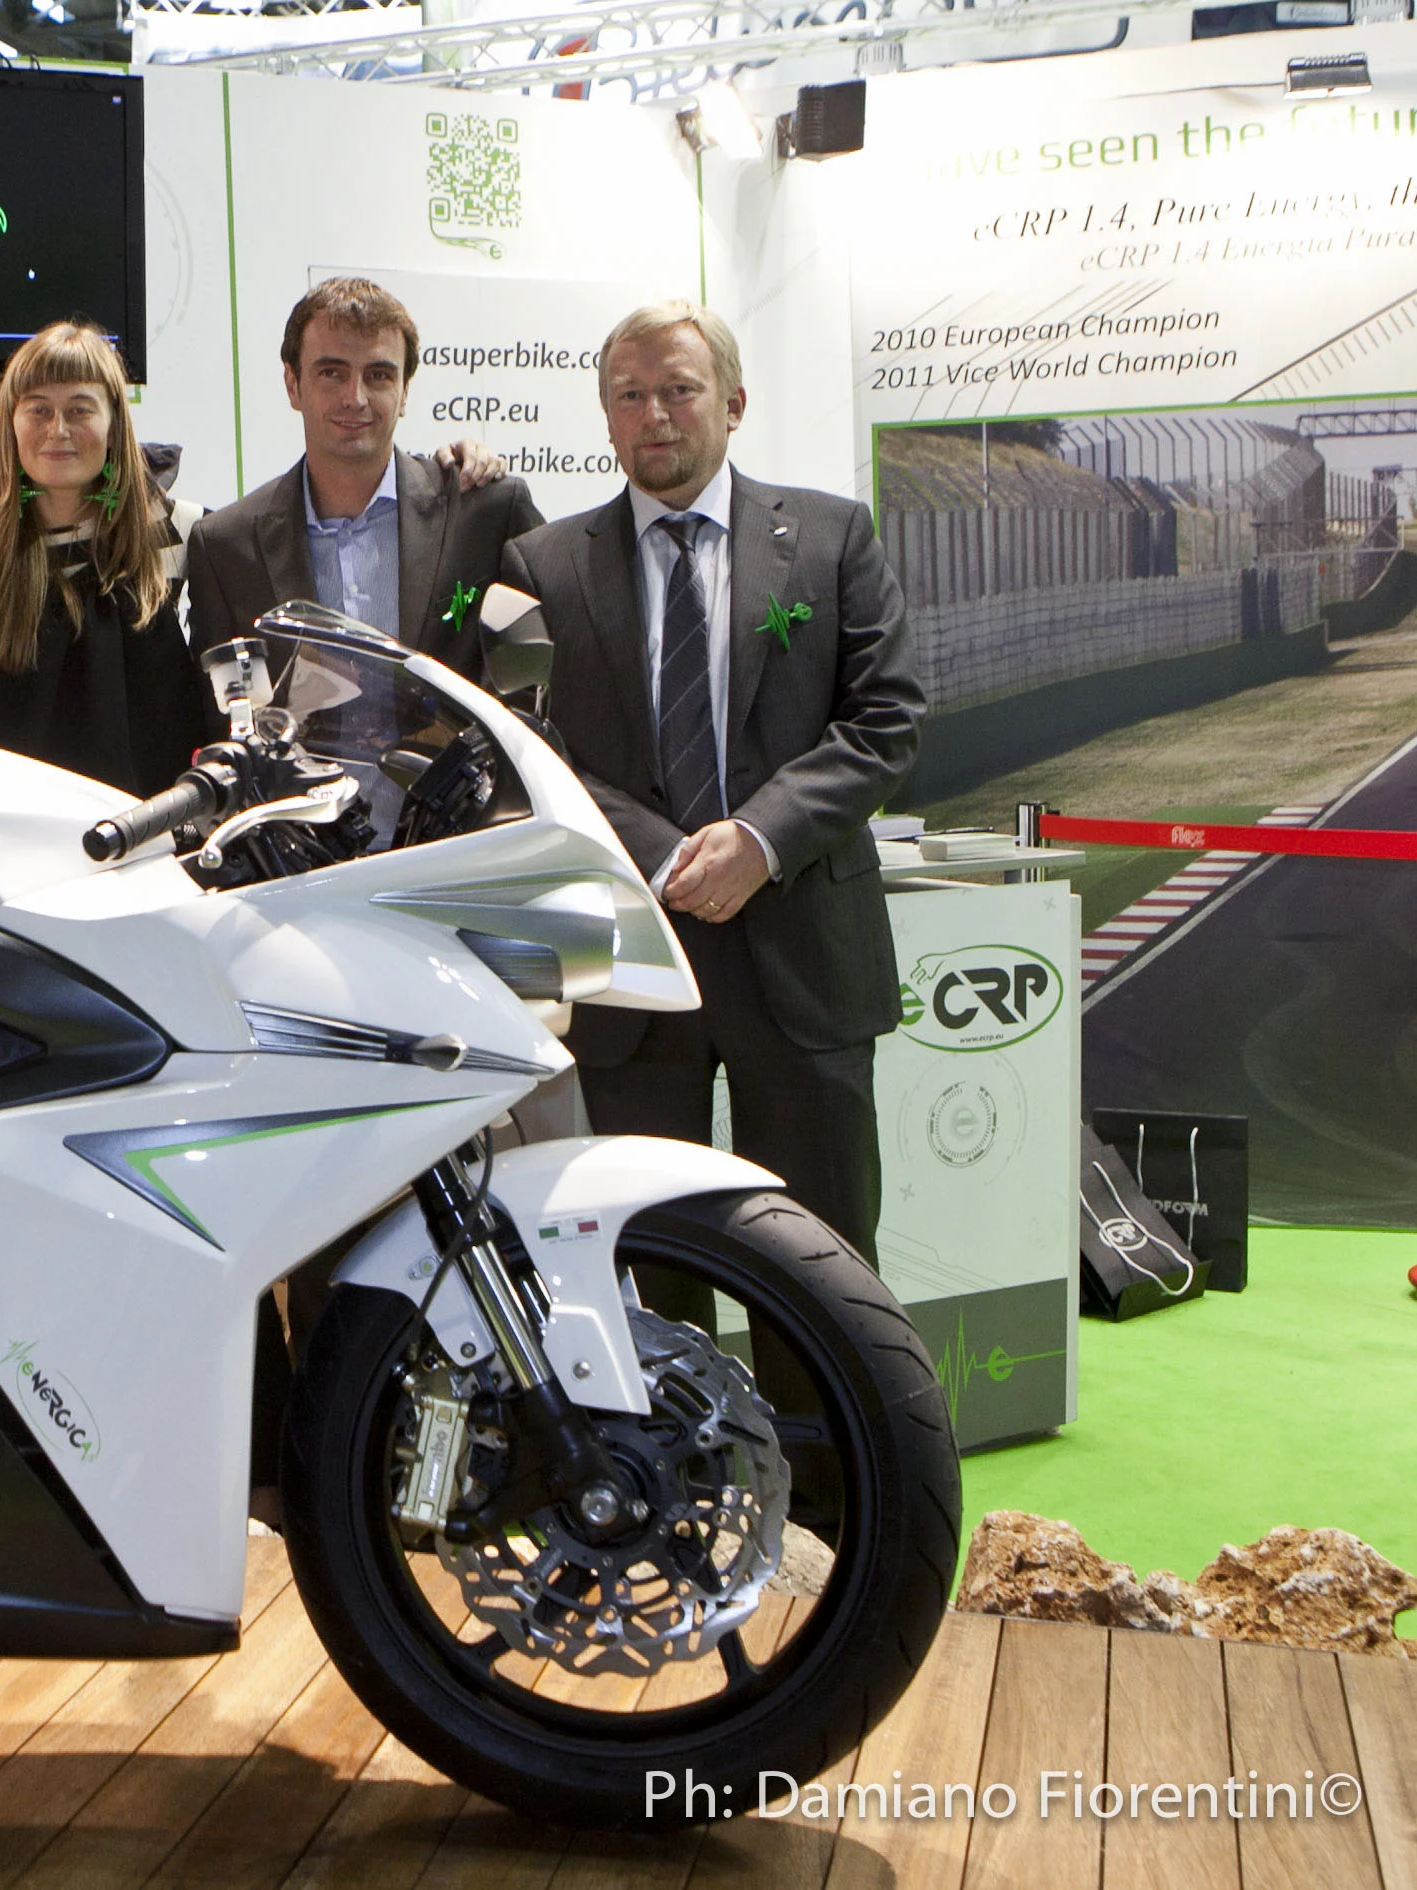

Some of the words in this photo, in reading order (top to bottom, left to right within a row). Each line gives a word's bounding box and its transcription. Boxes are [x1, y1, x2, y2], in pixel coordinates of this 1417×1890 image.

[1039, 132, 1160, 172] seen
[1177, 114, 1266, 159] the
[1081, 199, 1137, 237] 1.4,
[1151, 197, 1232, 227] Pure
[1079, 243, 1161, 273] eCRP
[1172, 239, 1211, 266] 1.4
[870, 327, 936, 354] 2010
[944, 319, 1071, 350] European
[1080, 308, 1221, 339] Champion
[871, 364, 935, 391] 2011
[946, 359, 999, 387] Vice
[1009, 353, 1089, 381] World
[1097, 346, 1238, 377] Champion
[432, 397, 539, 422] eCRP.eu
[959, 1032, 1004, 1044] www.ecrp.eu
